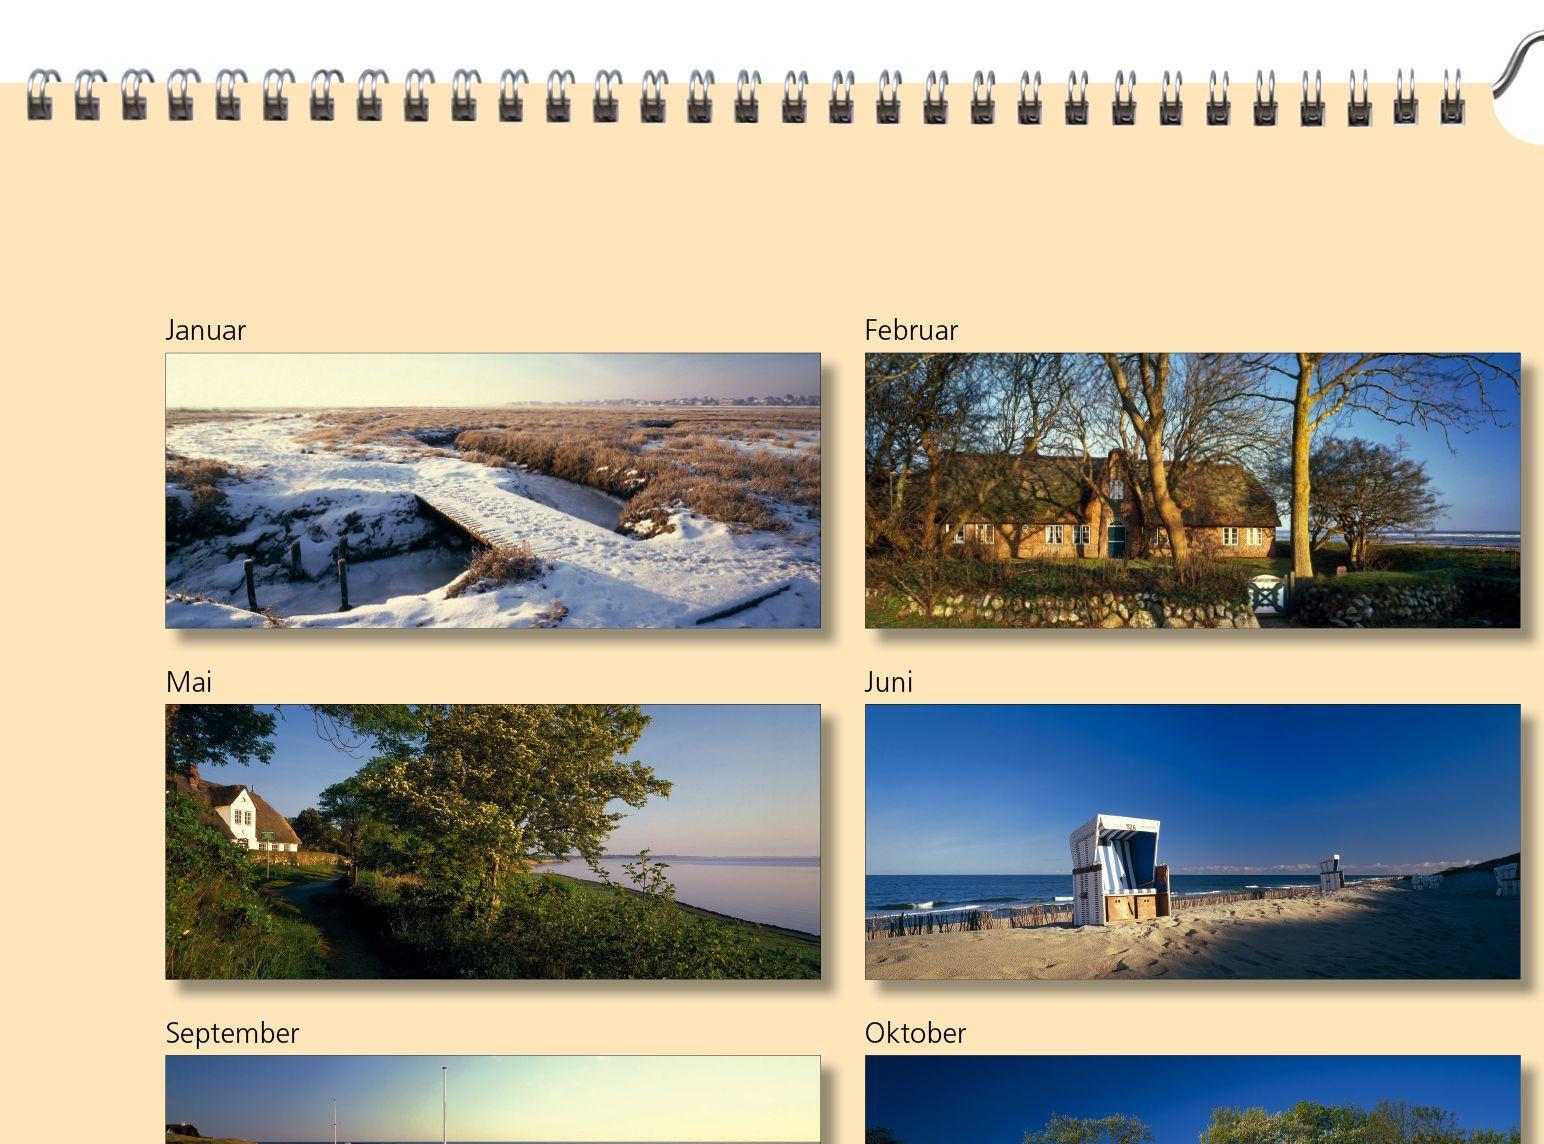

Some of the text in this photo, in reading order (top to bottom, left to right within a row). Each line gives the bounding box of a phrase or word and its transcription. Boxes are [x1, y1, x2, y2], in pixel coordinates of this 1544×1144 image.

[165, 318, 247, 341] Januar
[865, 317, 959, 341] Februar
[167, 669, 211, 693] Mai
[864, 669, 912, 693] Juni
[166, 1020, 300, 1050] September
[865, 1020, 967, 1044] Oktober
